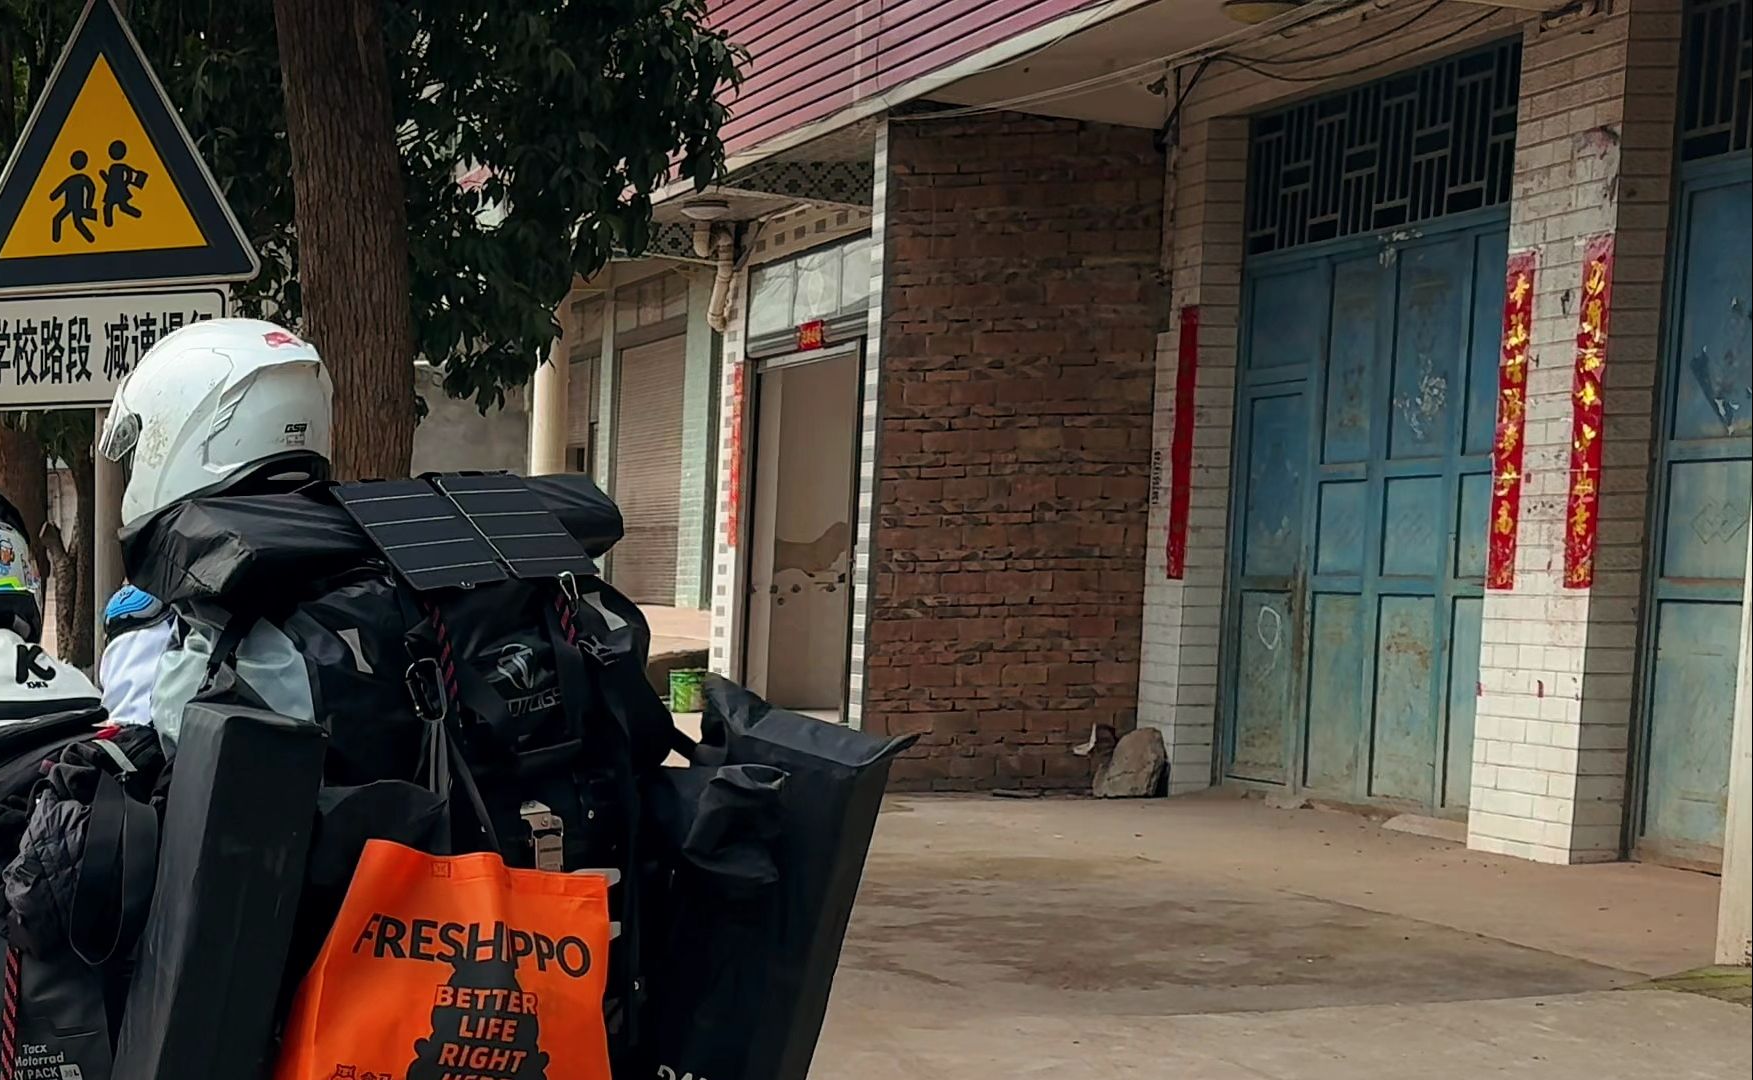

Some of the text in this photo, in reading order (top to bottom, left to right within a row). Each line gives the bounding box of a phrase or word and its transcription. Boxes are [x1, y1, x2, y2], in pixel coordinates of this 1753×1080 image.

[103, 309, 212, 382] 减速
[435, 985, 538, 1015] BETTER
[459, 1015, 518, 1042] LIFE
[437, 1042, 528, 1073] RIGHT
[28, 1066, 59, 1080] PACK
